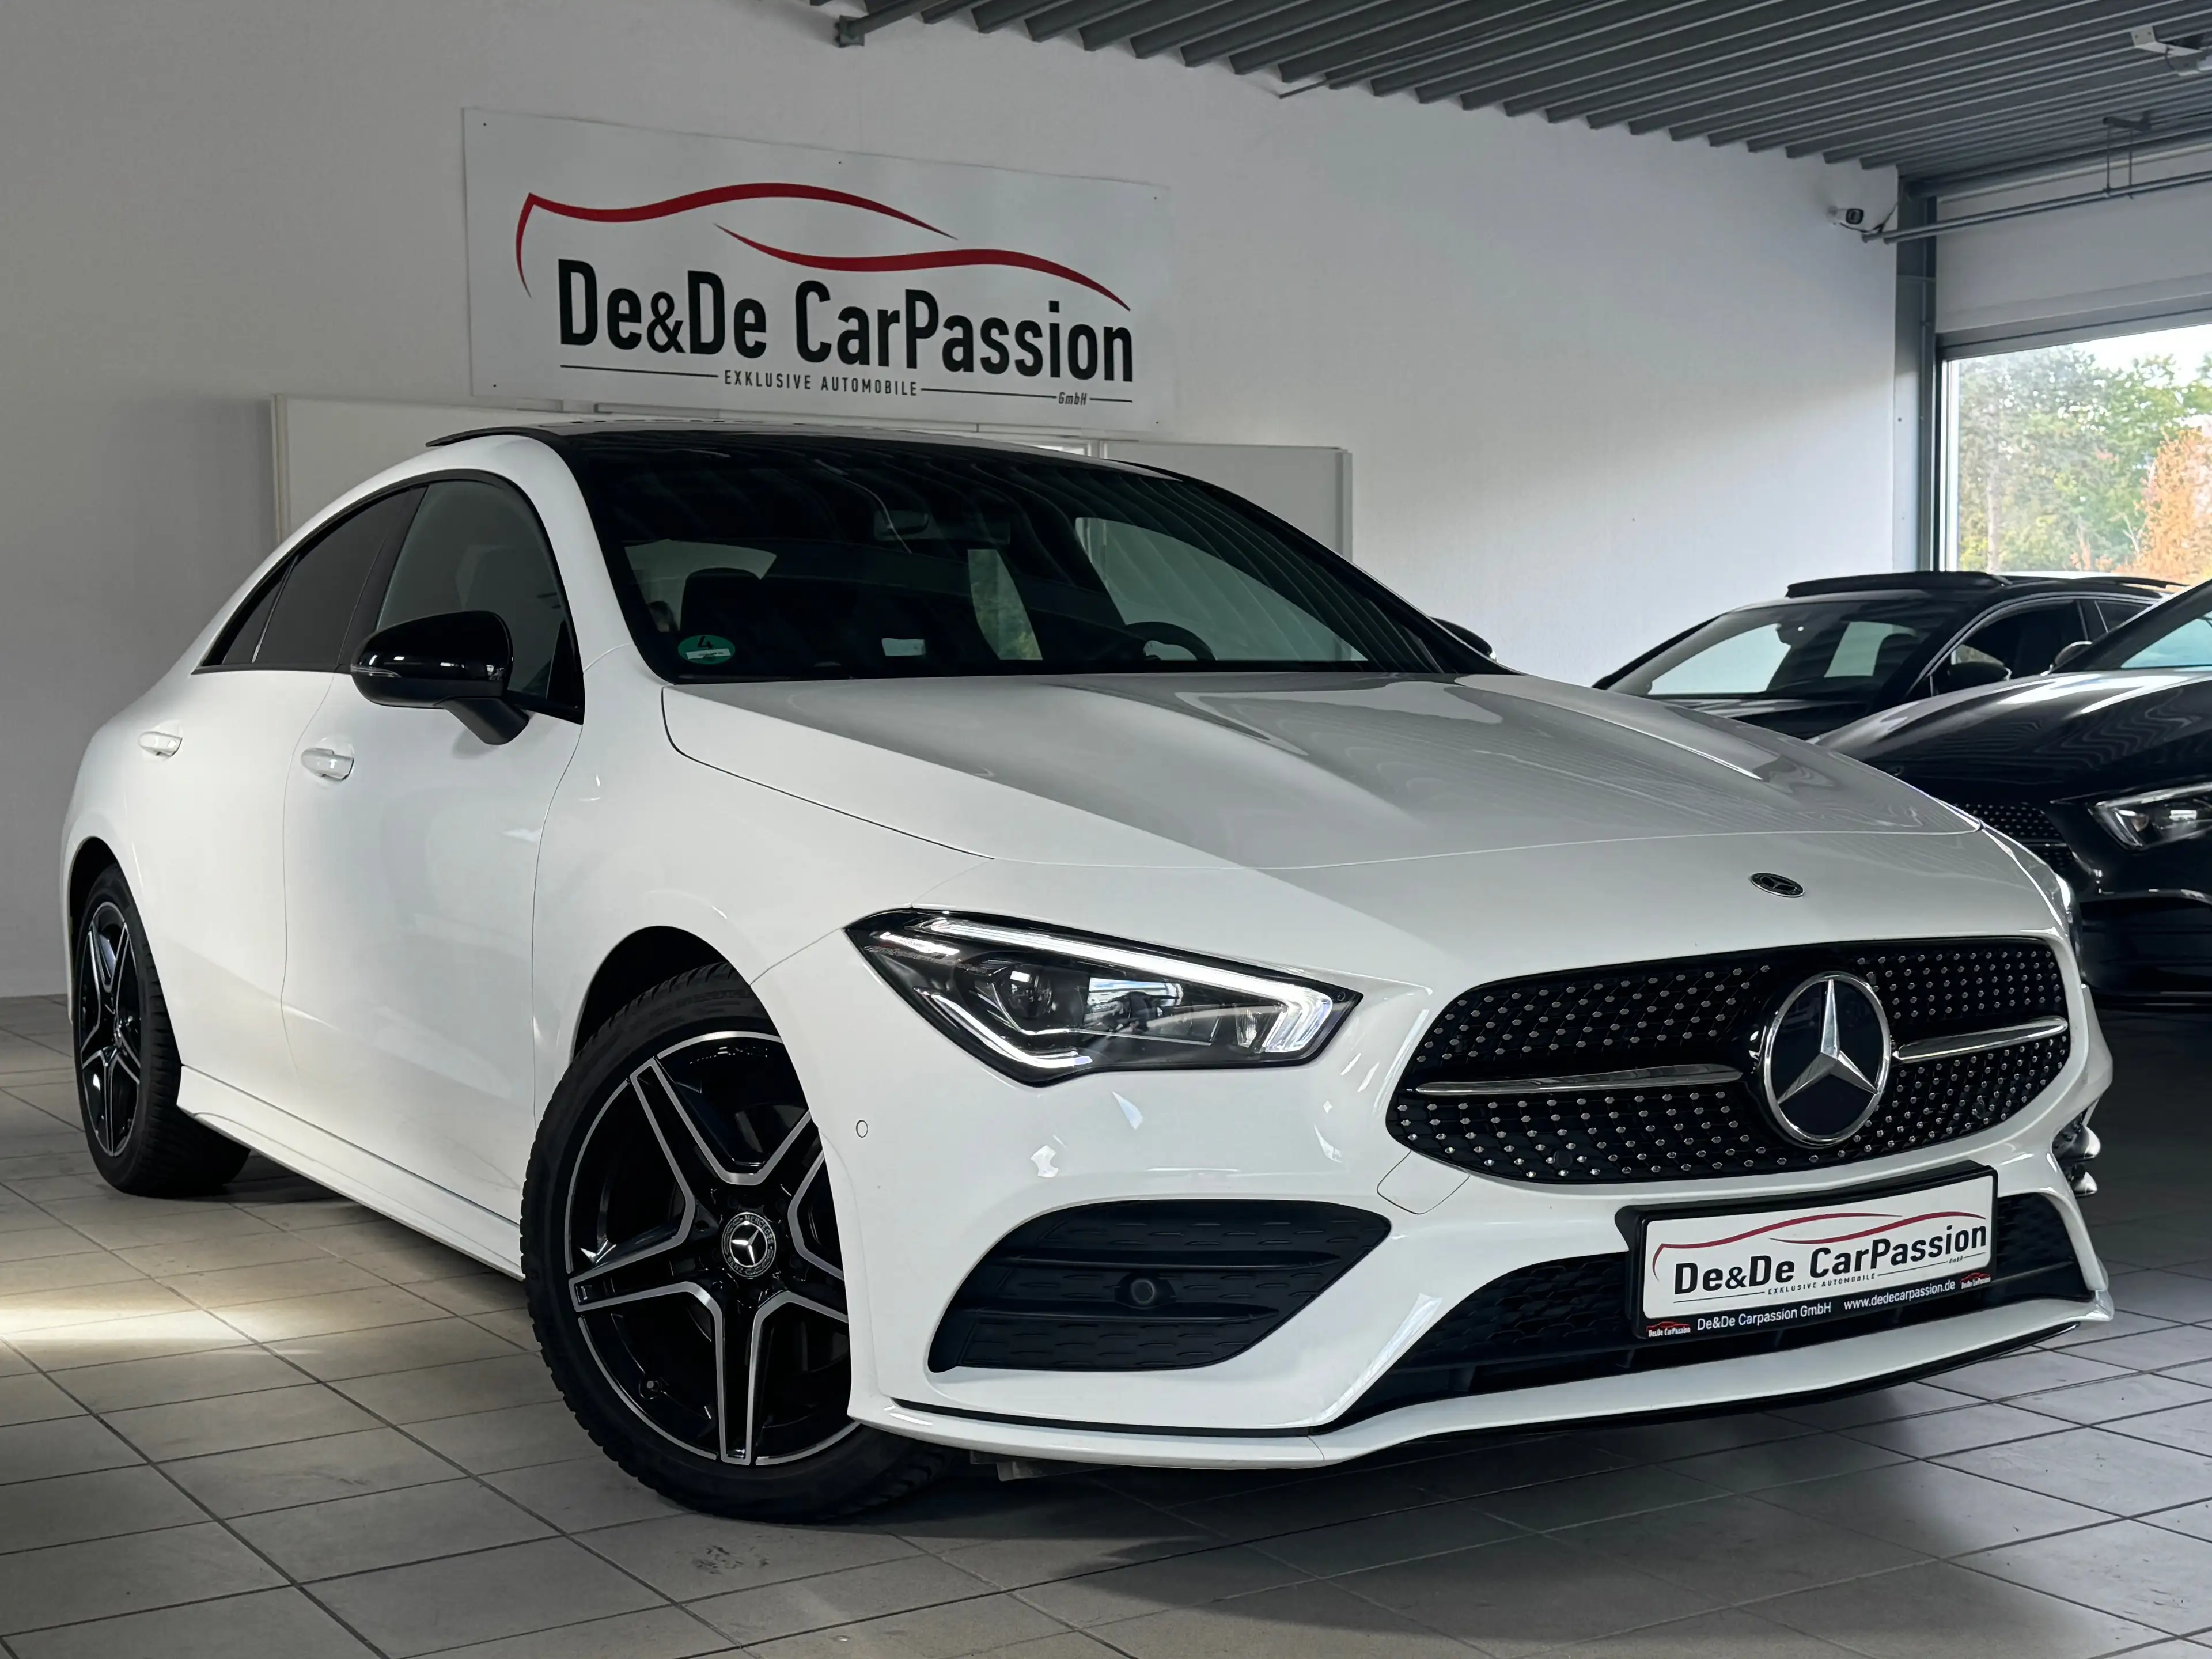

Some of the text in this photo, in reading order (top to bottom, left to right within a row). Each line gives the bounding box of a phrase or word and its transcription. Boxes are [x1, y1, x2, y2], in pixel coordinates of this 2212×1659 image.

[558, 258, 1132, 382] De&De CarPassion
[724, 369, 917, 396] EXKLUSIVE AUTOMOBILE
[1058, 391, 1087, 406] GmbH
[1675, 1225, 1986, 1295] De&De CarPassion
[1697, 1316, 1736, 1331] De&De
[1738, 1307, 1797, 1327] Carpassion
[1800, 1301, 1831, 1317] GmbH
[1844, 1279, 1956, 1310] www.dedecarpassion.de
